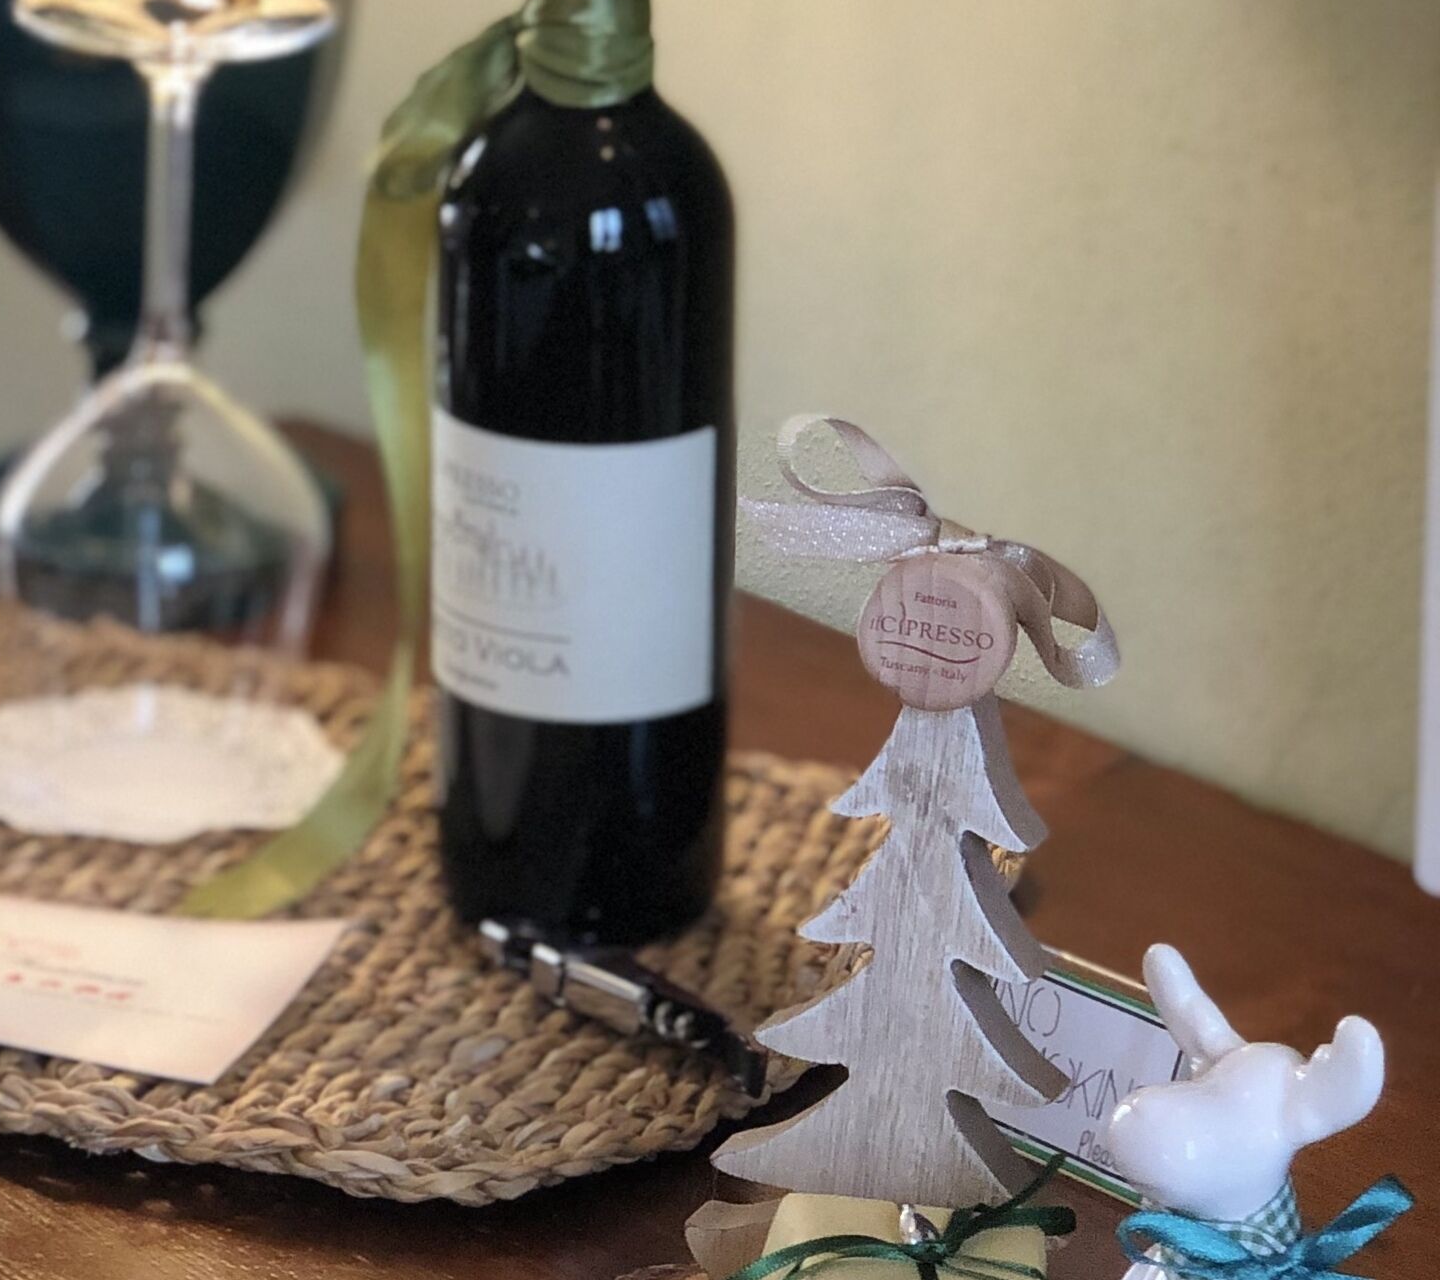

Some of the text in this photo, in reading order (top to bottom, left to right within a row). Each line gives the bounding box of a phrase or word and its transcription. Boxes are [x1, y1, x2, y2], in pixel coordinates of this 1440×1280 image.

[914, 591, 957, 609] Fattoria
[880, 656, 929, 679] Tuscany
[941, 667, 967, 684] Italy
